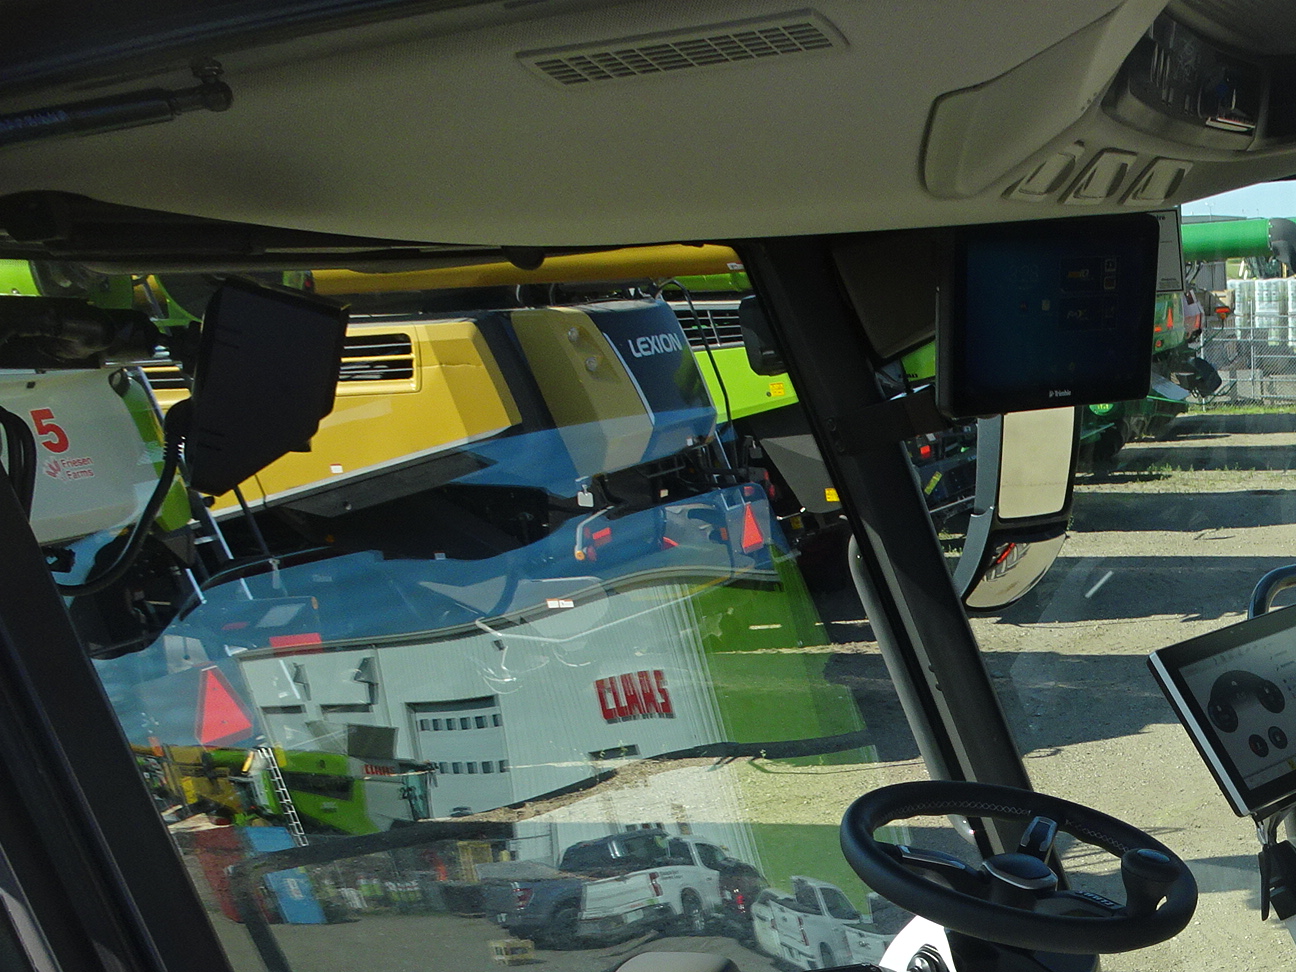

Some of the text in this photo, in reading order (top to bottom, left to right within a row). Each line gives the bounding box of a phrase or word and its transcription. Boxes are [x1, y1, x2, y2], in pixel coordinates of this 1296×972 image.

[627, 332, 683, 358] LEXION
[30, 408, 70, 454] 5
[60, 457, 94, 469] Friesen
[65, 469, 95, 480] Farms
[595, 669, 673, 720] CLAAS
